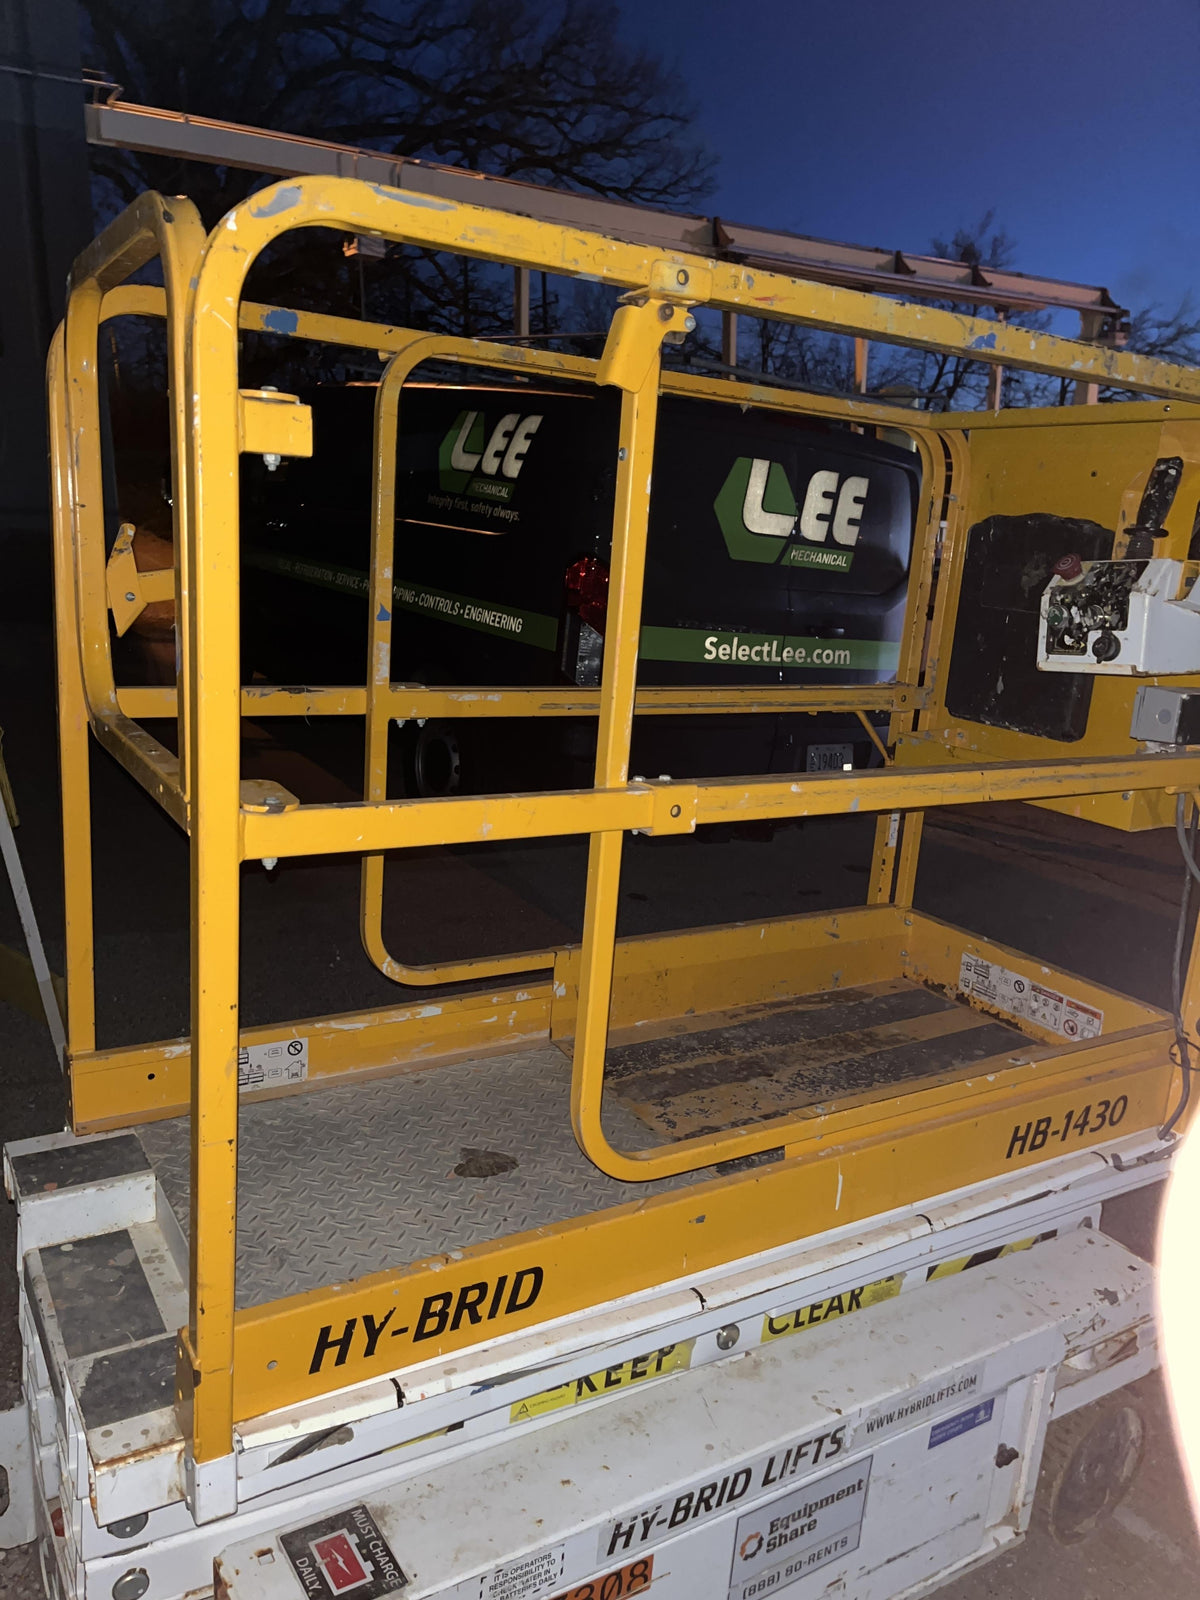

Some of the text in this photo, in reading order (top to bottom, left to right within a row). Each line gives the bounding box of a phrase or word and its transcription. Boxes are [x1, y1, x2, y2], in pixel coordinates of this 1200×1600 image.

[451, 411, 544, 479] LEE
[470, 501, 494, 518] safety
[493, 505, 520, 523] always.
[743, 458, 870, 547] LEE
[790, 549, 847, 567] MECHANICAL
[419, 592, 459, 616] CONTROLS
[464, 604, 523, 634] ENGINEERING
[703, 636, 851, 665] SelectLee.com
[1006, 1094, 1129, 1160] HB-1430
[308, 1266, 544, 1376] HY-BRID
[767, 1285, 866, 1336] CLEAR
[866, 1374, 978, 1434] WWW.HYBRIDLIFTS.COM
[606, 1424, 847, 1557] HY-BRID LIFTS
[768, 1477, 864, 1536] Equipment
[351, 1508, 403, 1589] MUST CHARGE
[765, 1518, 818, 1554] Share
[295, 1556, 323, 1591] DAILY
[489, 1558, 556, 1592] RESPONSIBILITY TO
[510, 1552, 552, 1575] OPERATORS
[538, 1572, 558, 1587] DAILY
[543, 1568, 551, 1576] IN
[742, 1536, 849, 1600] (888) 80-RENTS
